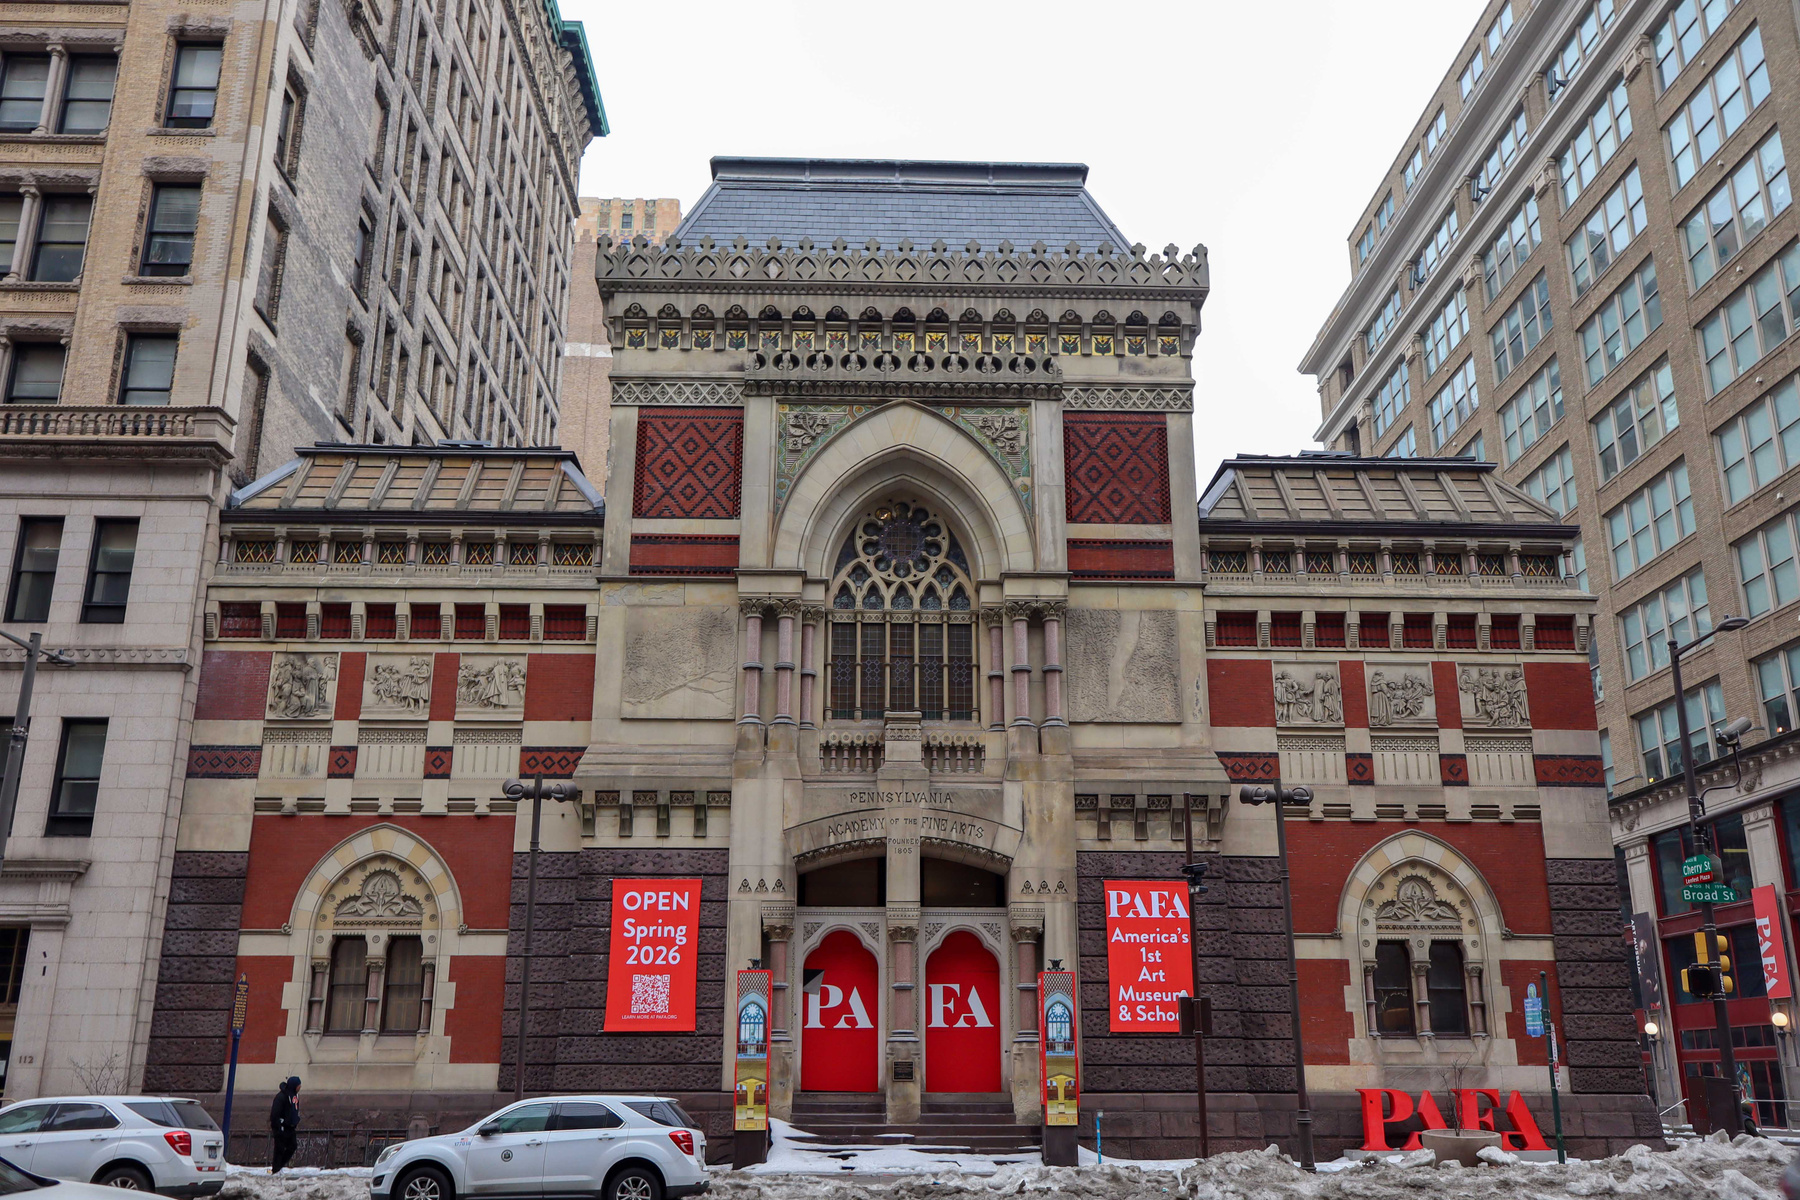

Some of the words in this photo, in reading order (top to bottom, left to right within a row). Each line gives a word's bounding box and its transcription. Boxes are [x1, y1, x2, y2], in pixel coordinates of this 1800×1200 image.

[850, 792, 953, 804] PENNSYLVANIA
[827, 817, 885, 838] ACADEMY
[921, 816, 948, 831] FINE
[950, 821, 984, 839] ARTS
[1683, 864, 1702, 875] Cherry
[1703, 861, 1711, 871] St
[622, 891, 689, 911] OPEN
[1107, 890, 1190, 918] PAFA
[1683, 890, 1718, 900] Broad
[1723, 891, 1734, 900] St
[623, 918, 687, 945] Spring
[625, 945, 681, 965] 2026
[1139, 947, 1162, 963] 1st
[1633, 937, 1641, 974] MUSEUM
[1755, 915, 1779, 993] PAFA
[1138, 965, 1166, 982] Art
[803, 984, 874, 1029] PA
[927, 983, 995, 1028] FA
[1118, 1005, 1132, 1021] &
[1136, 1005, 1179, 1022] Scho
[19, 1055, 34, 1064] 112
[1355, 1088, 1552, 1151] PAFA
